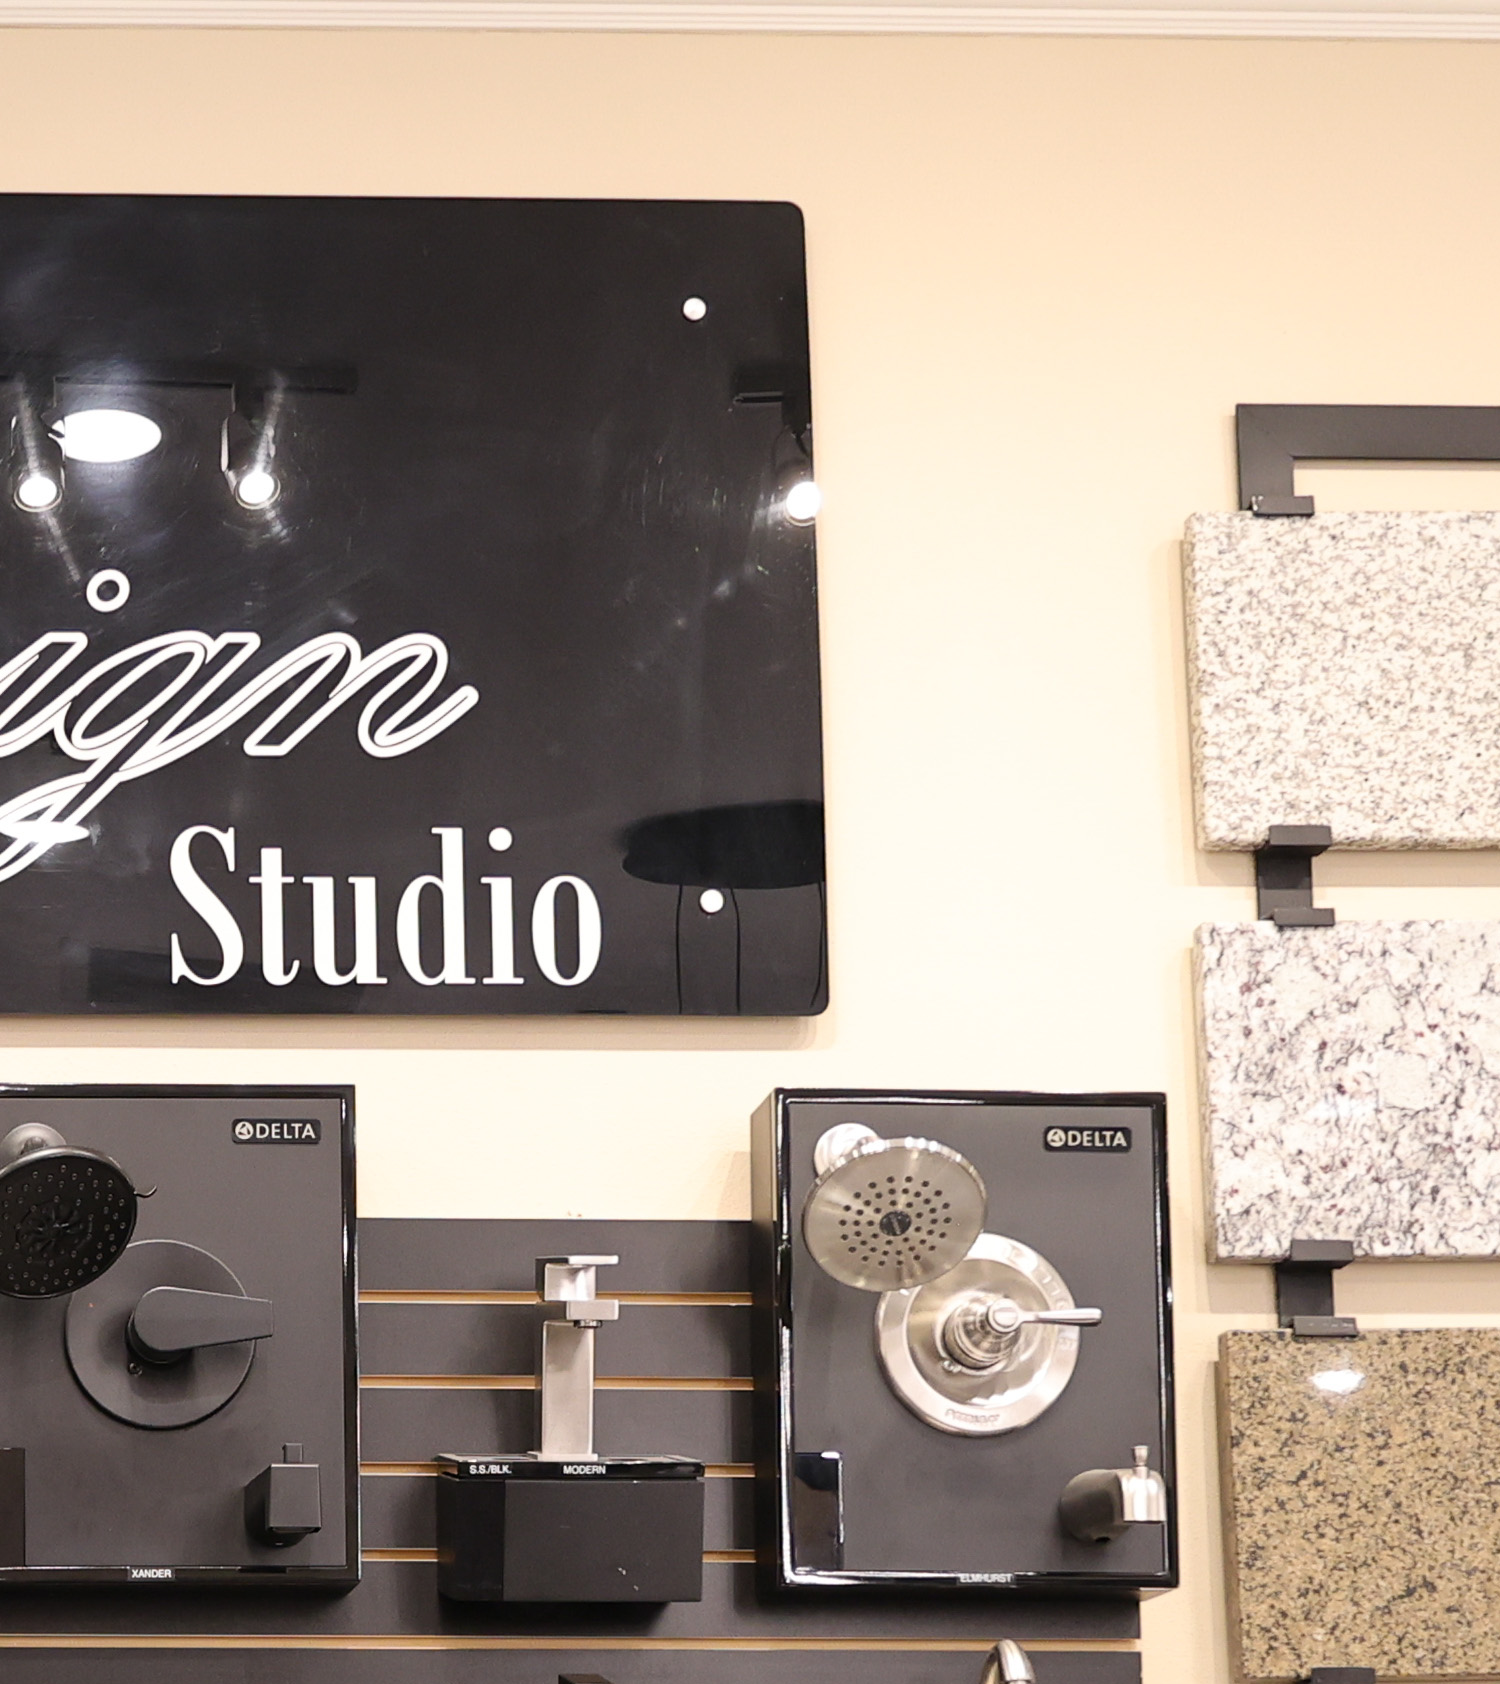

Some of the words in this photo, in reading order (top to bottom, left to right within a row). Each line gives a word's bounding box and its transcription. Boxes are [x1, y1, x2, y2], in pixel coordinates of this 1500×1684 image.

[168, 825, 603, 987] Studio
[255, 1122, 316, 1139] DELTA
[1067, 1130, 1127, 1147] DELTA
[563, 1464, 606, 1475] MODERN
[131, 1568, 172, 1579] XANDER
[960, 1572, 1014, 1583] ELMHURST
